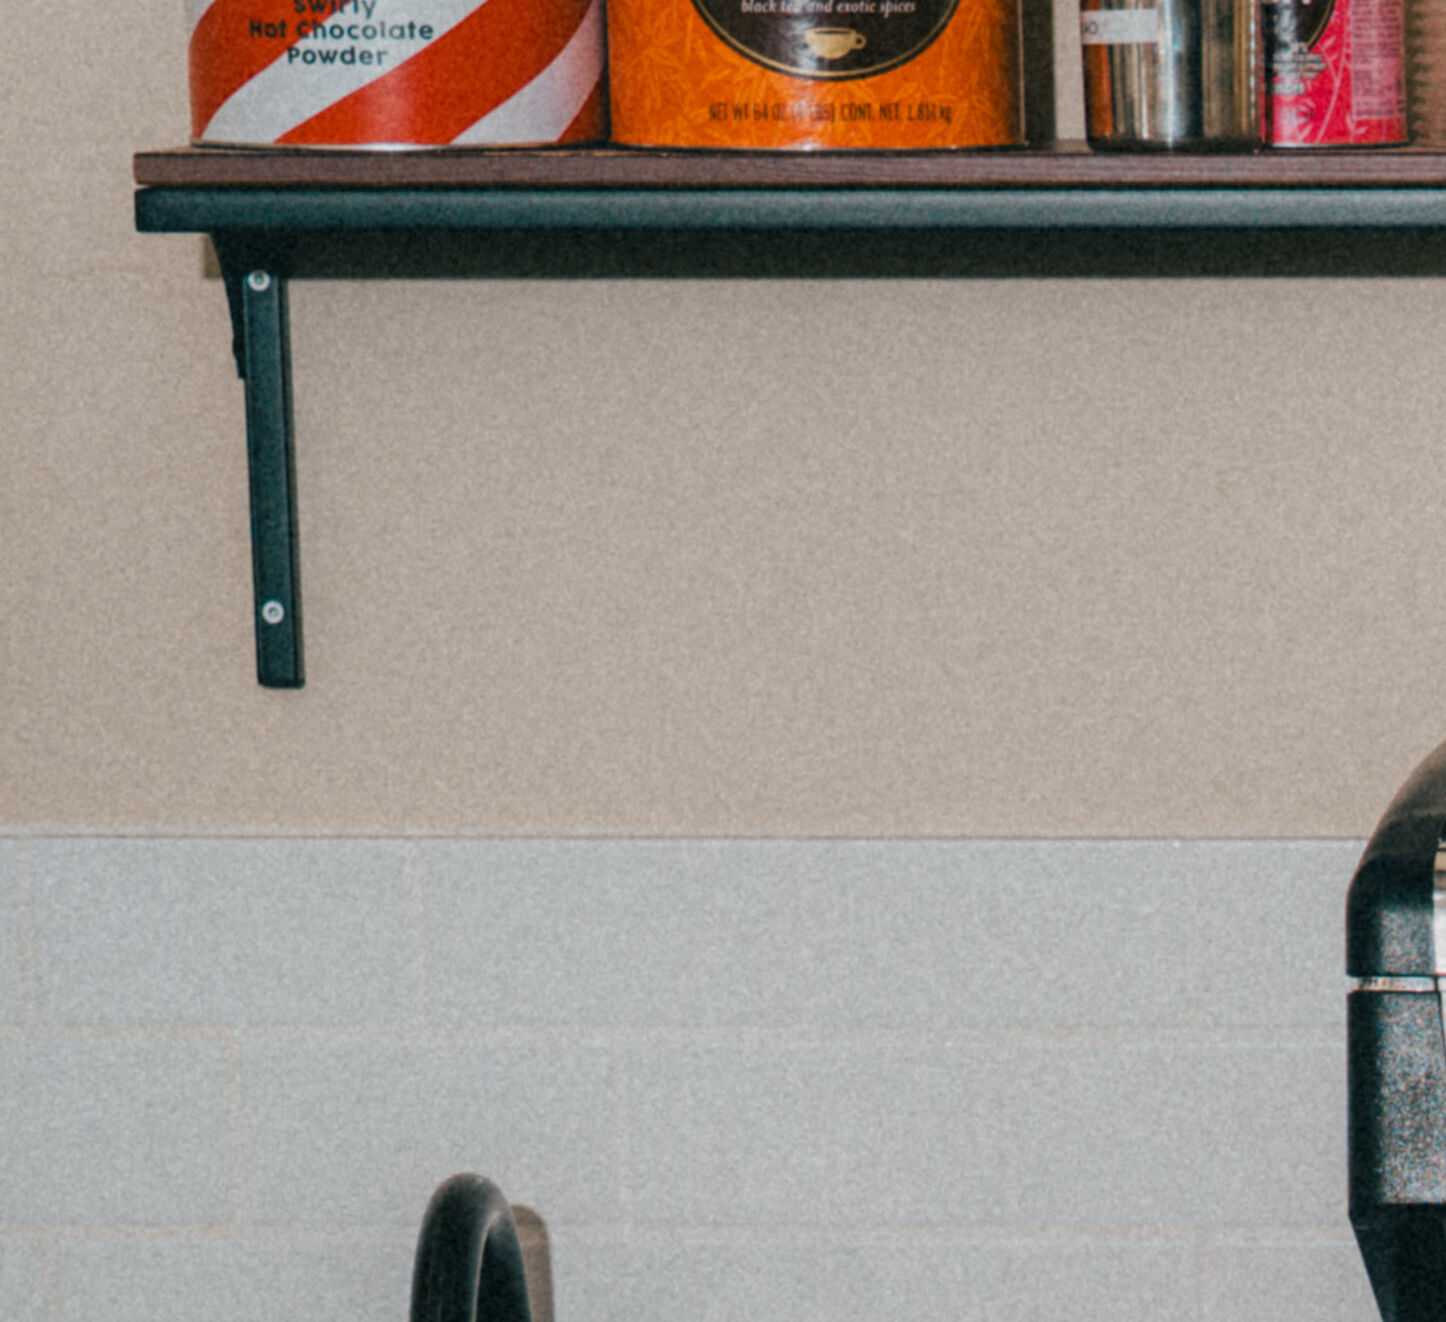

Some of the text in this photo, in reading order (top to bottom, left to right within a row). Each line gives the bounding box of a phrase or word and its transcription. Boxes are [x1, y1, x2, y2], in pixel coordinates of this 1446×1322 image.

[293, 0, 376, 19] Swirly
[250, 20, 435, 39] Hot Chocolate
[287, 46, 388, 65] Powder
